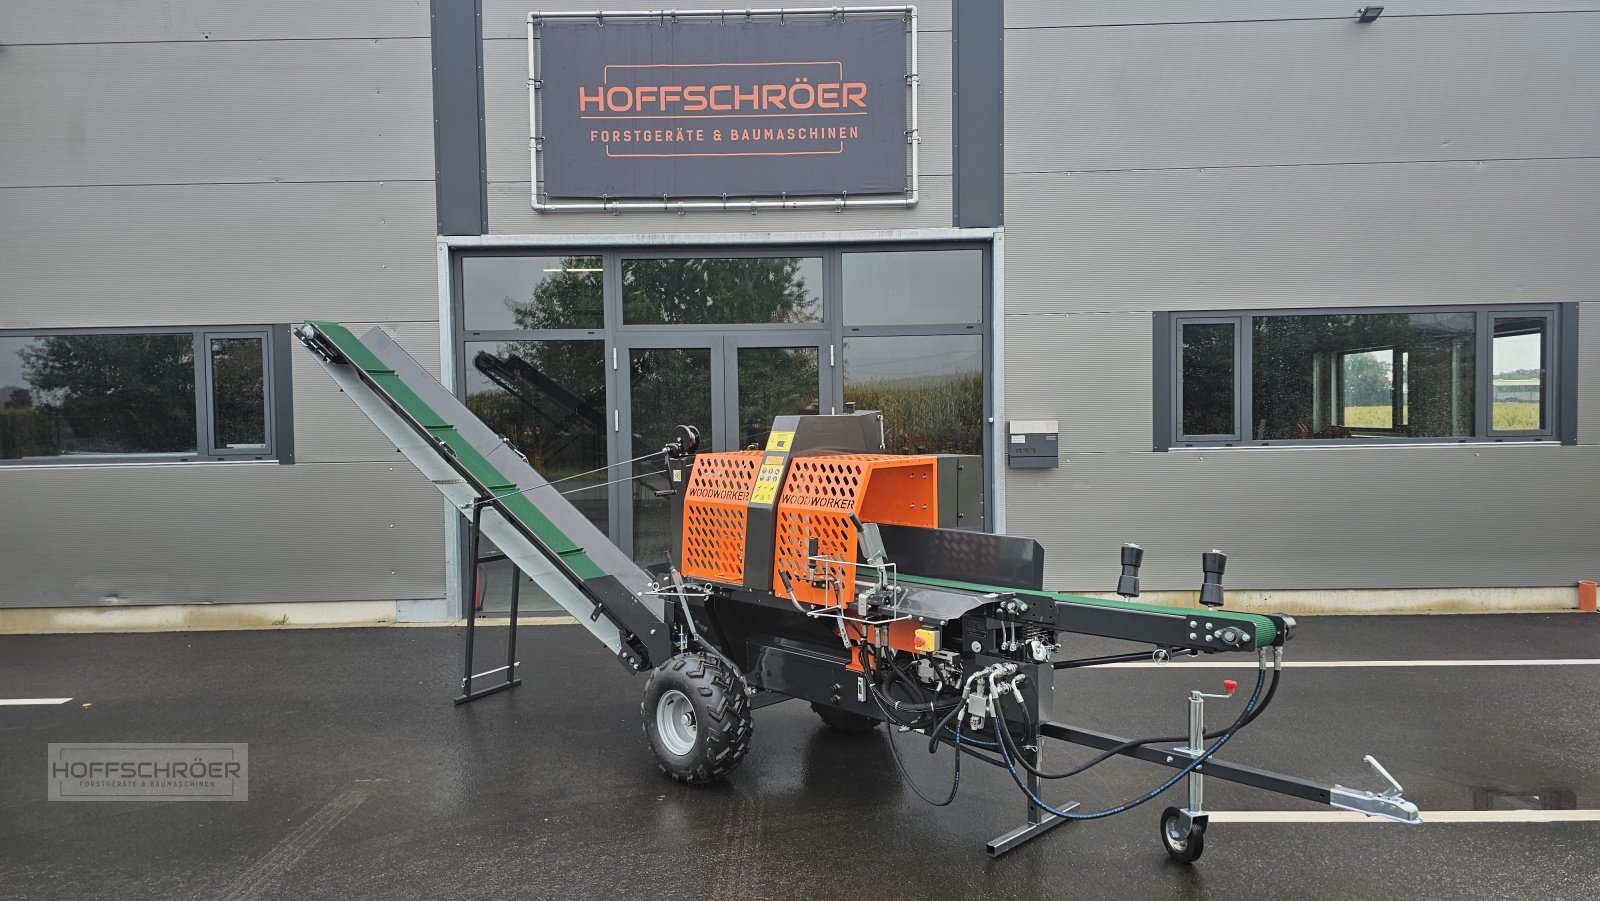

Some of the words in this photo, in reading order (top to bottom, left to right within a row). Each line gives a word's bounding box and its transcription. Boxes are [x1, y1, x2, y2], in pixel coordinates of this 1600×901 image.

[579, 76, 868, 112] HOFFSCHRÖER
[590, 127, 704, 142] FORSTGERÄTE
[713, 130, 722, 141] &
[731, 126, 859, 141] BAUMASCHINEN
[689, 488, 750, 501] WOODWORKER
[782, 494, 856, 510] WOODWORKER
